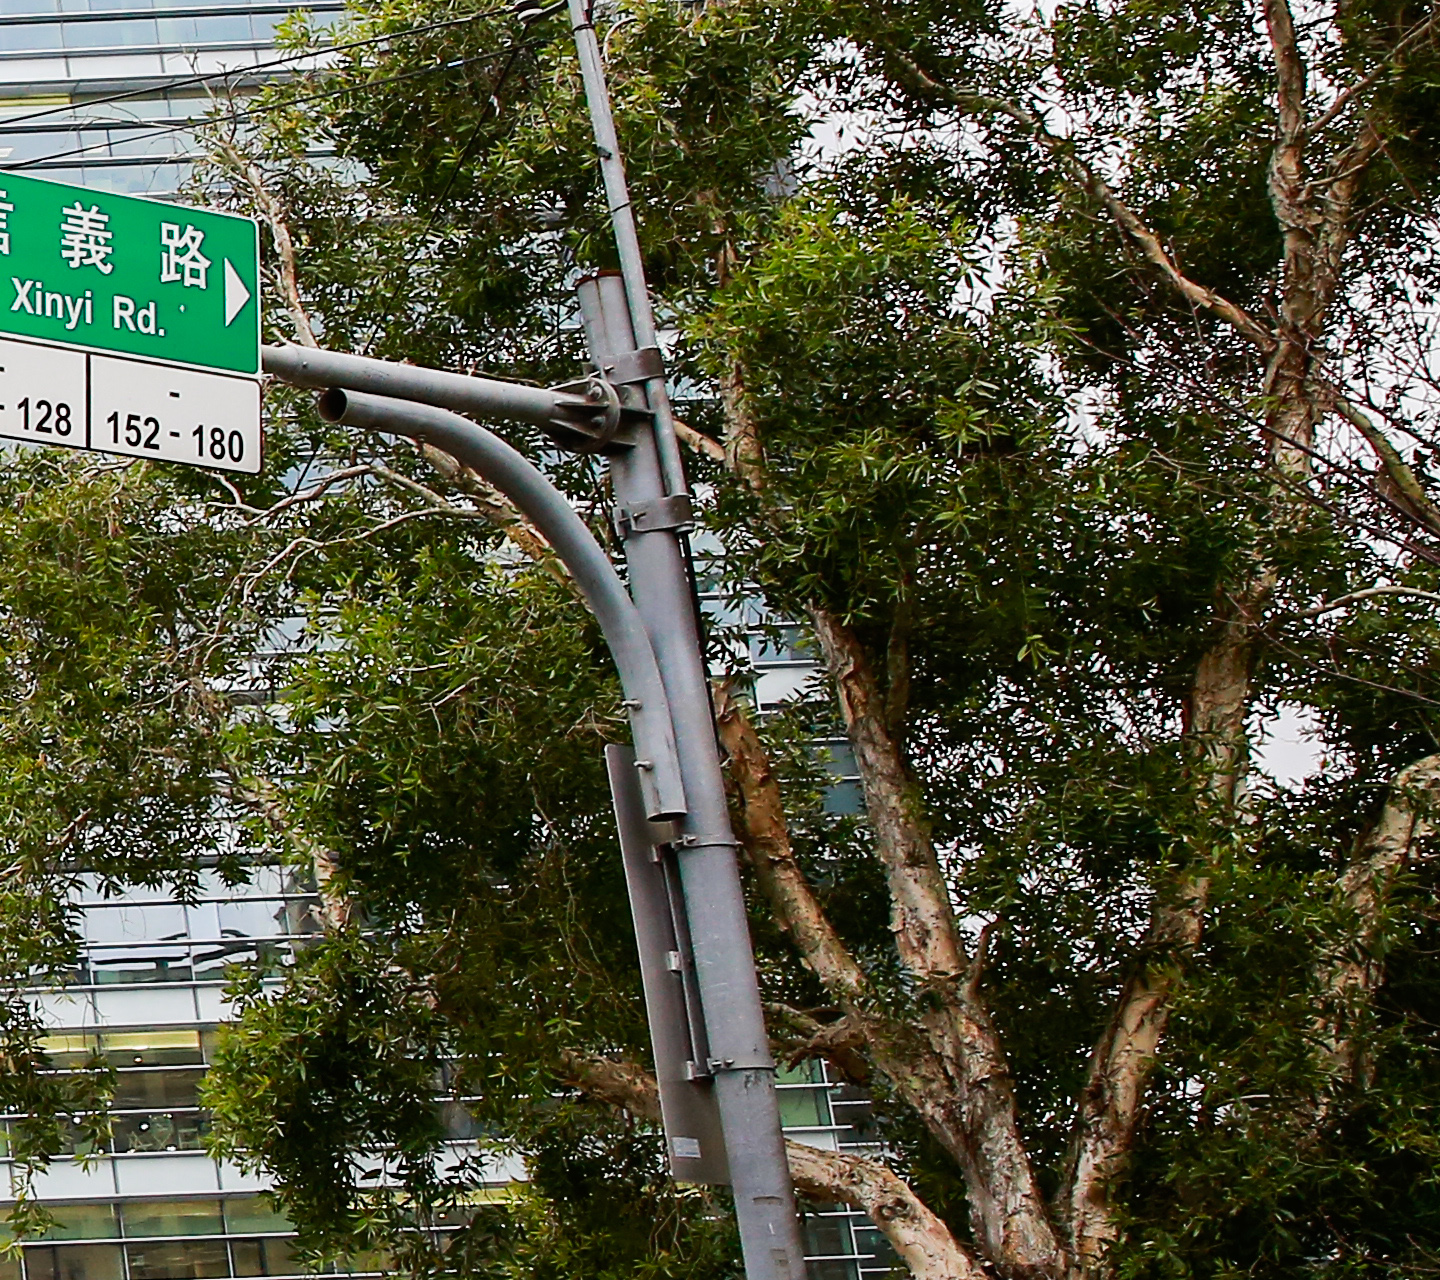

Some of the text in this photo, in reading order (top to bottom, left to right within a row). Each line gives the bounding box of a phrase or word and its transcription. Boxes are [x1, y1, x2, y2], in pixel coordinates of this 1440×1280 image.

[10, 276, 166, 337] Xinyi Rd.
[17, 397, 72, 436] 128
[106, 411, 161, 451] 152
[191, 425, 244, 463] 180
